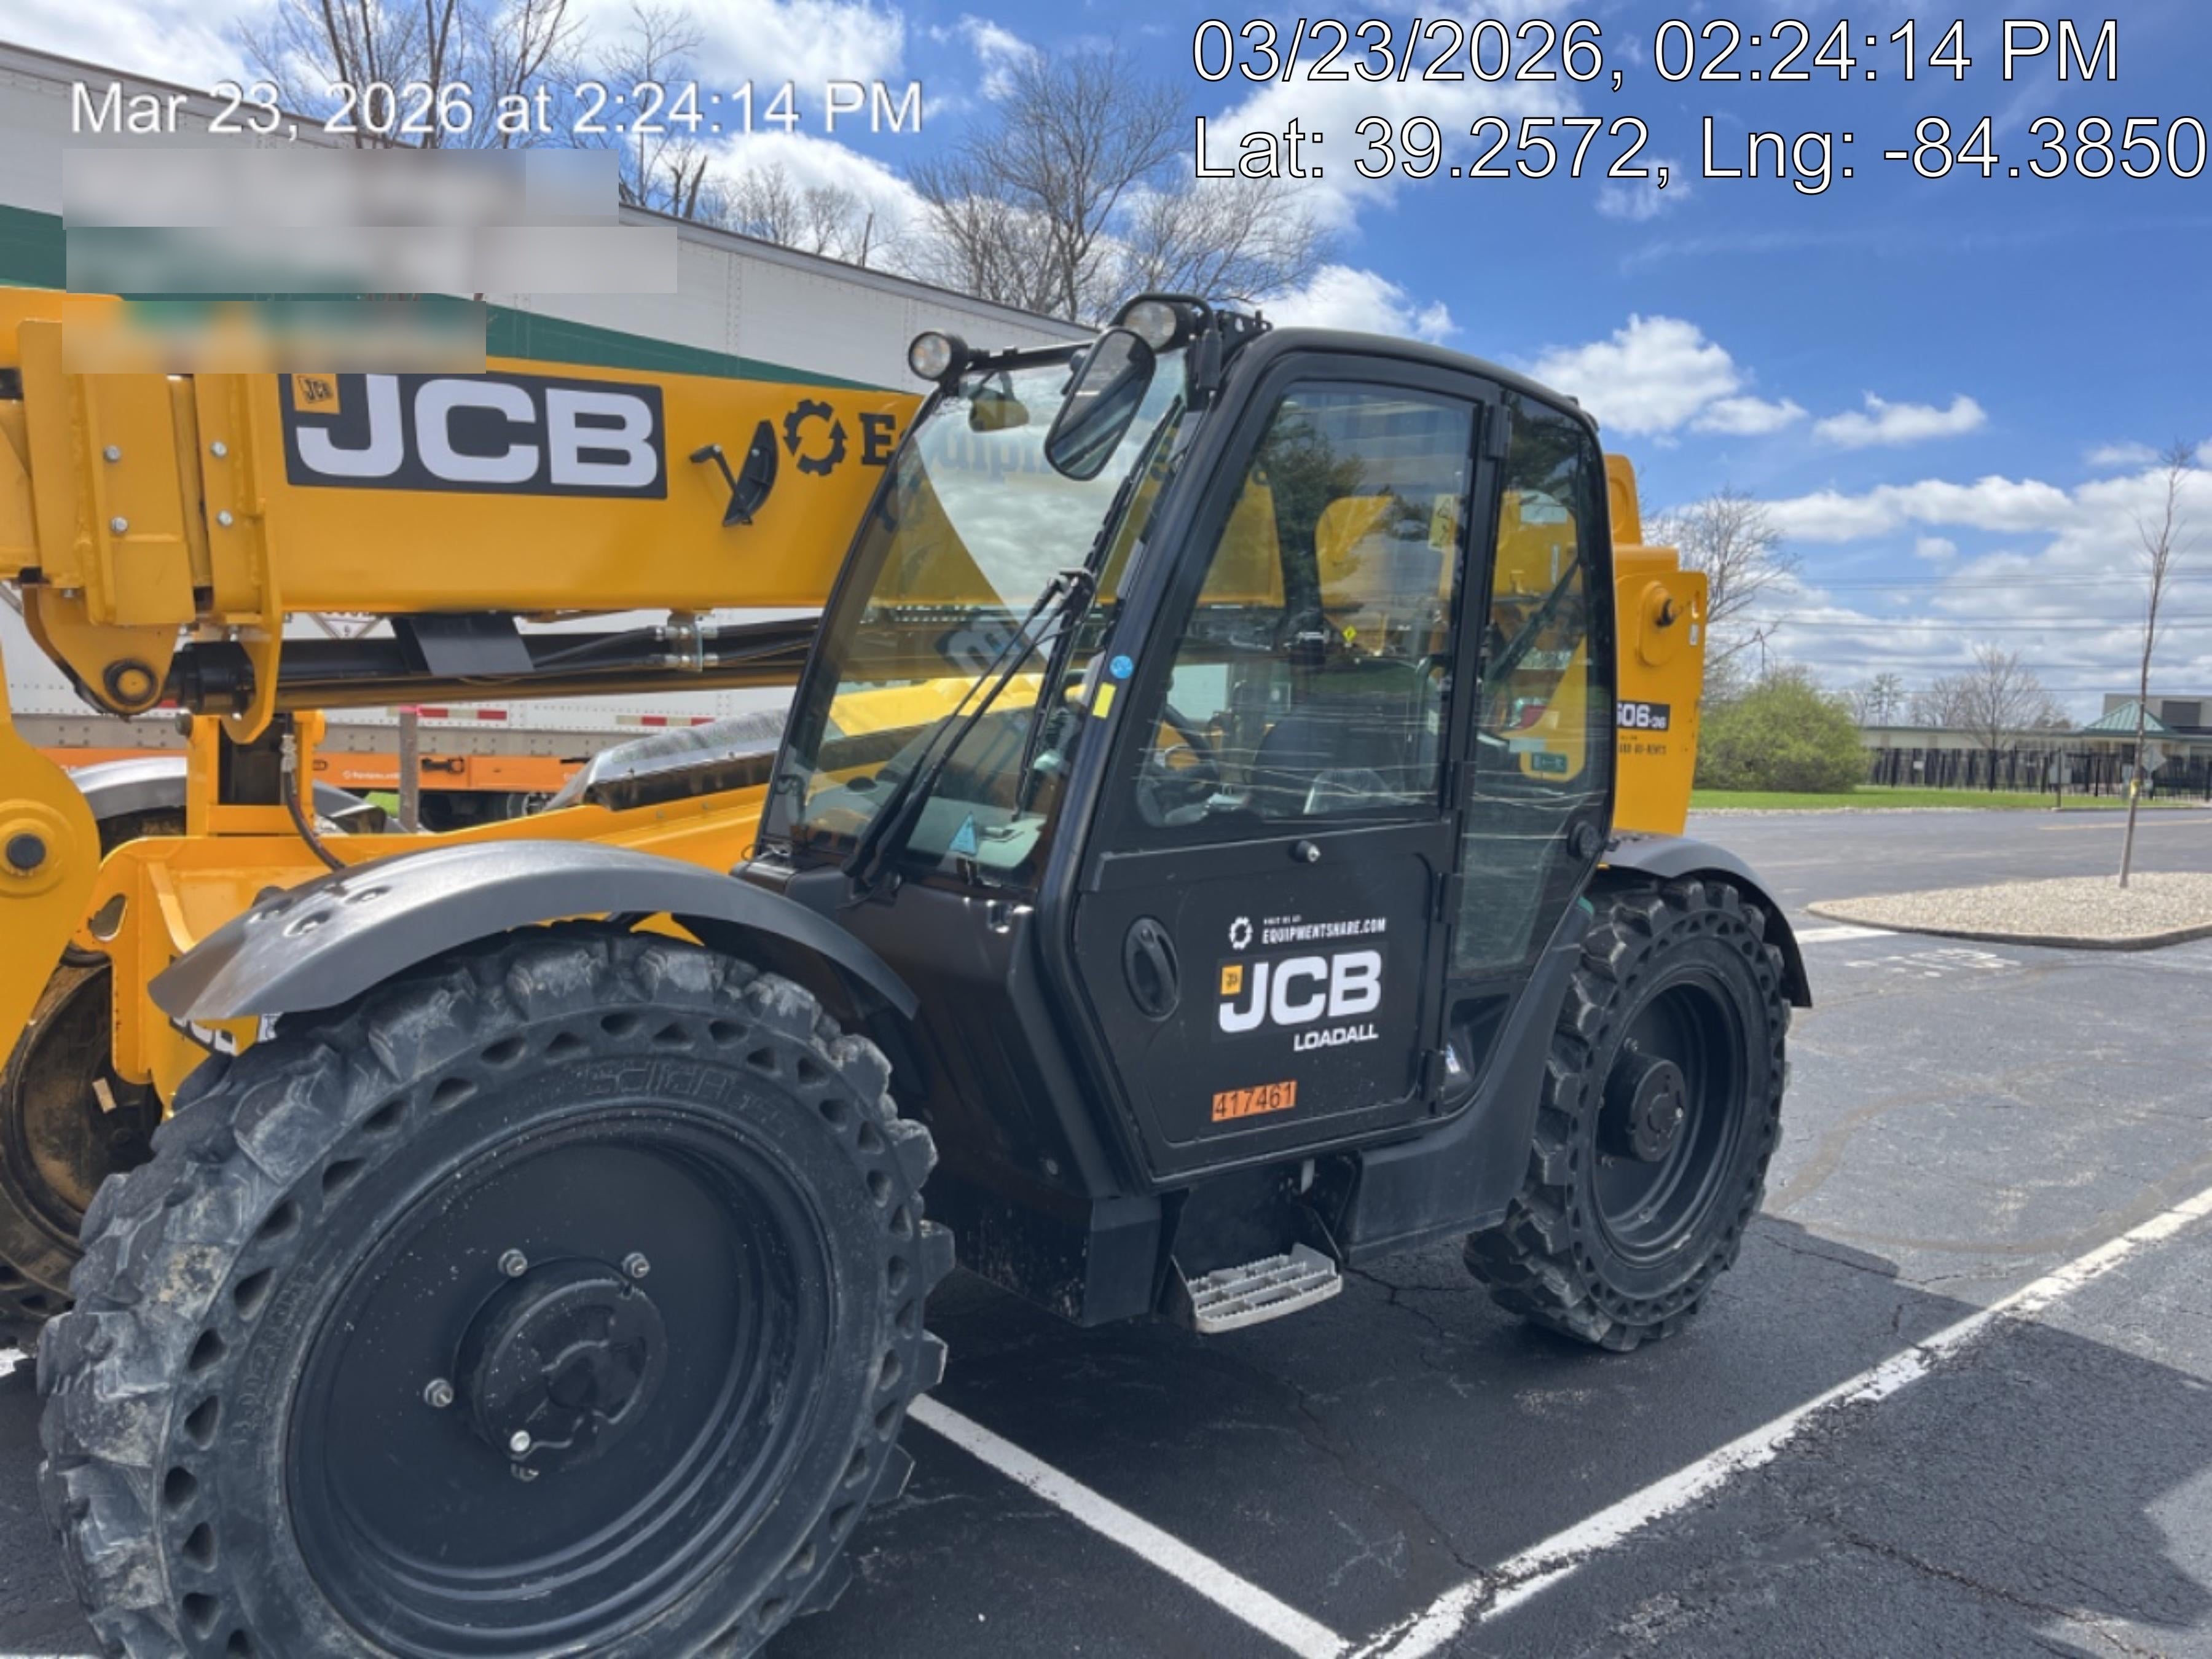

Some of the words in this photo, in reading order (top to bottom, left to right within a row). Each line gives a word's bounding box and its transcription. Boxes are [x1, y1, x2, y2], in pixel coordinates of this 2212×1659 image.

[296, 374, 657, 487] JCB
[1219, 949, 1382, 1033] JCB
[1293, 1023, 1379, 1051] LOADALL
[1214, 1084, 1292, 1117] 417461
